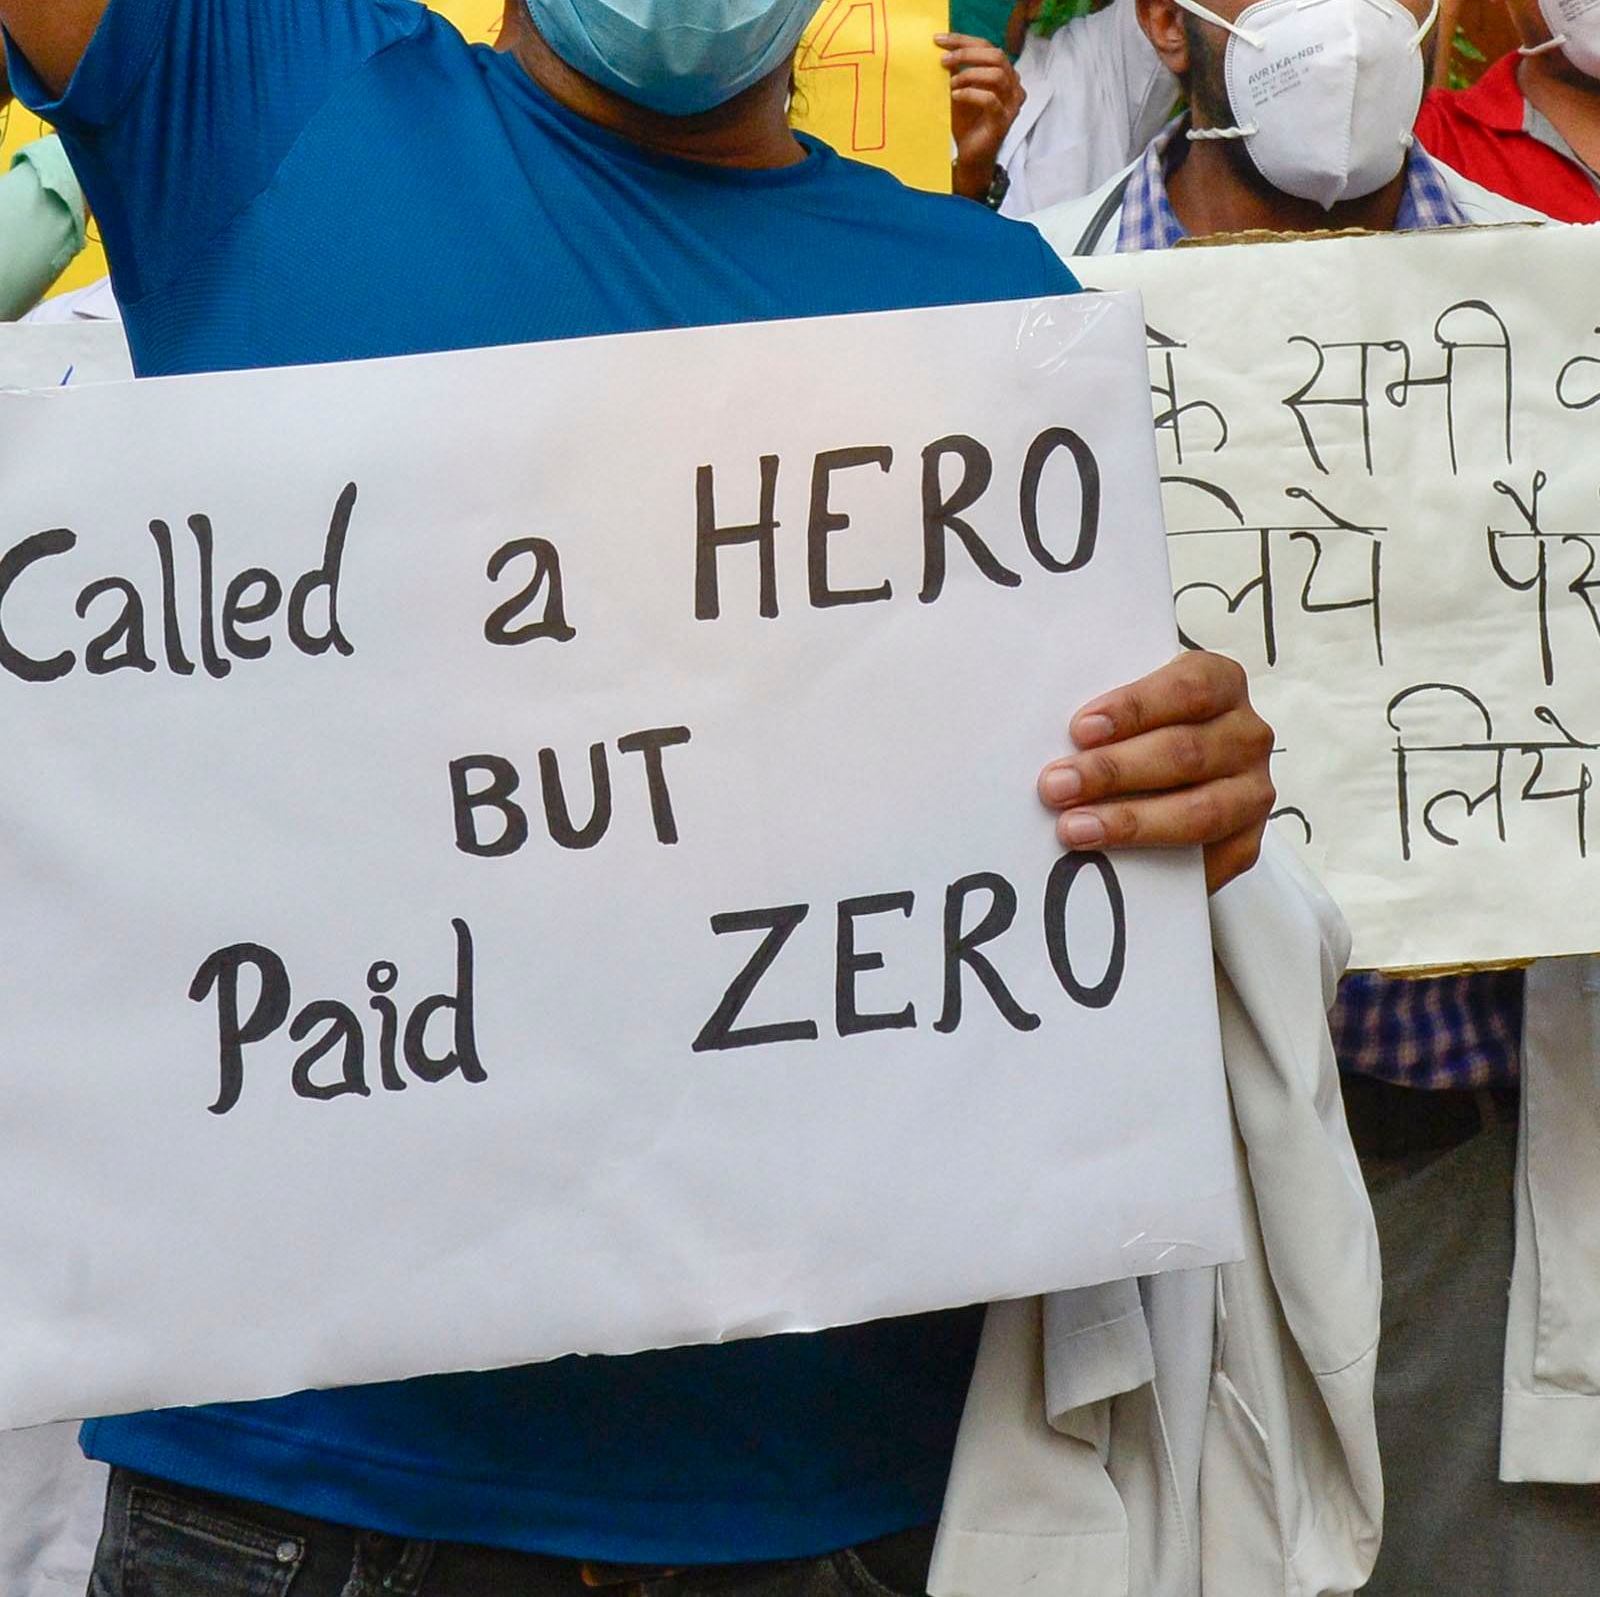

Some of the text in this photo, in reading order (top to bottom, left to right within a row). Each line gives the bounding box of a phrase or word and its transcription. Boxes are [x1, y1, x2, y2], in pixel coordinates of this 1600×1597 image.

[1280, 299, 1514, 476] सभी
[481, 535, 577, 646] a
[692, 424, 1102, 622] HERO
[452, 724, 693, 858] BUT
[187, 850, 1128, 1116] Paid ZERO
